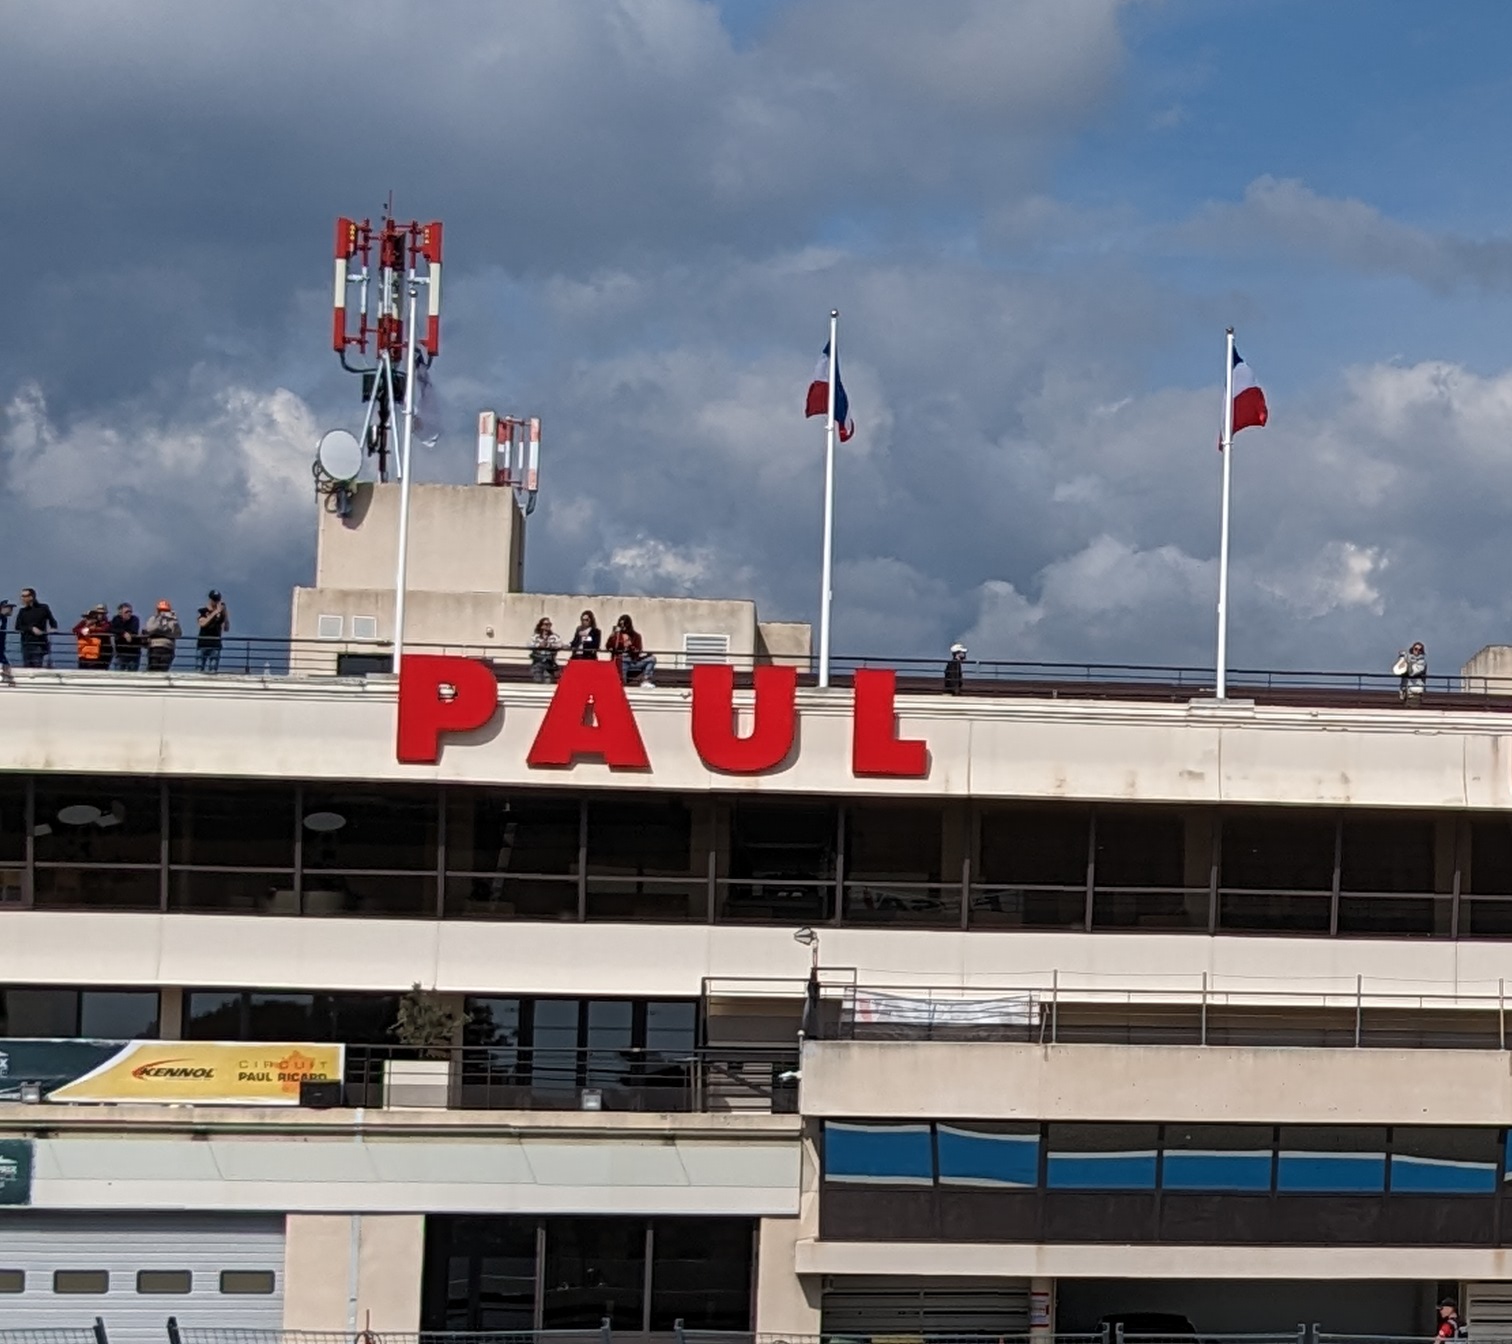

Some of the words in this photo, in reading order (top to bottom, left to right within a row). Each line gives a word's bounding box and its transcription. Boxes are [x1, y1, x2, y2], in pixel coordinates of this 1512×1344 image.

[396, 655, 928, 777] PAUL
[238, 1059, 328, 1070] CIRCUIT
[140, 1066, 215, 1079] KENNOL
[238, 1072, 273, 1082] PAUL
[277, 1072, 327, 1082] RICARD
